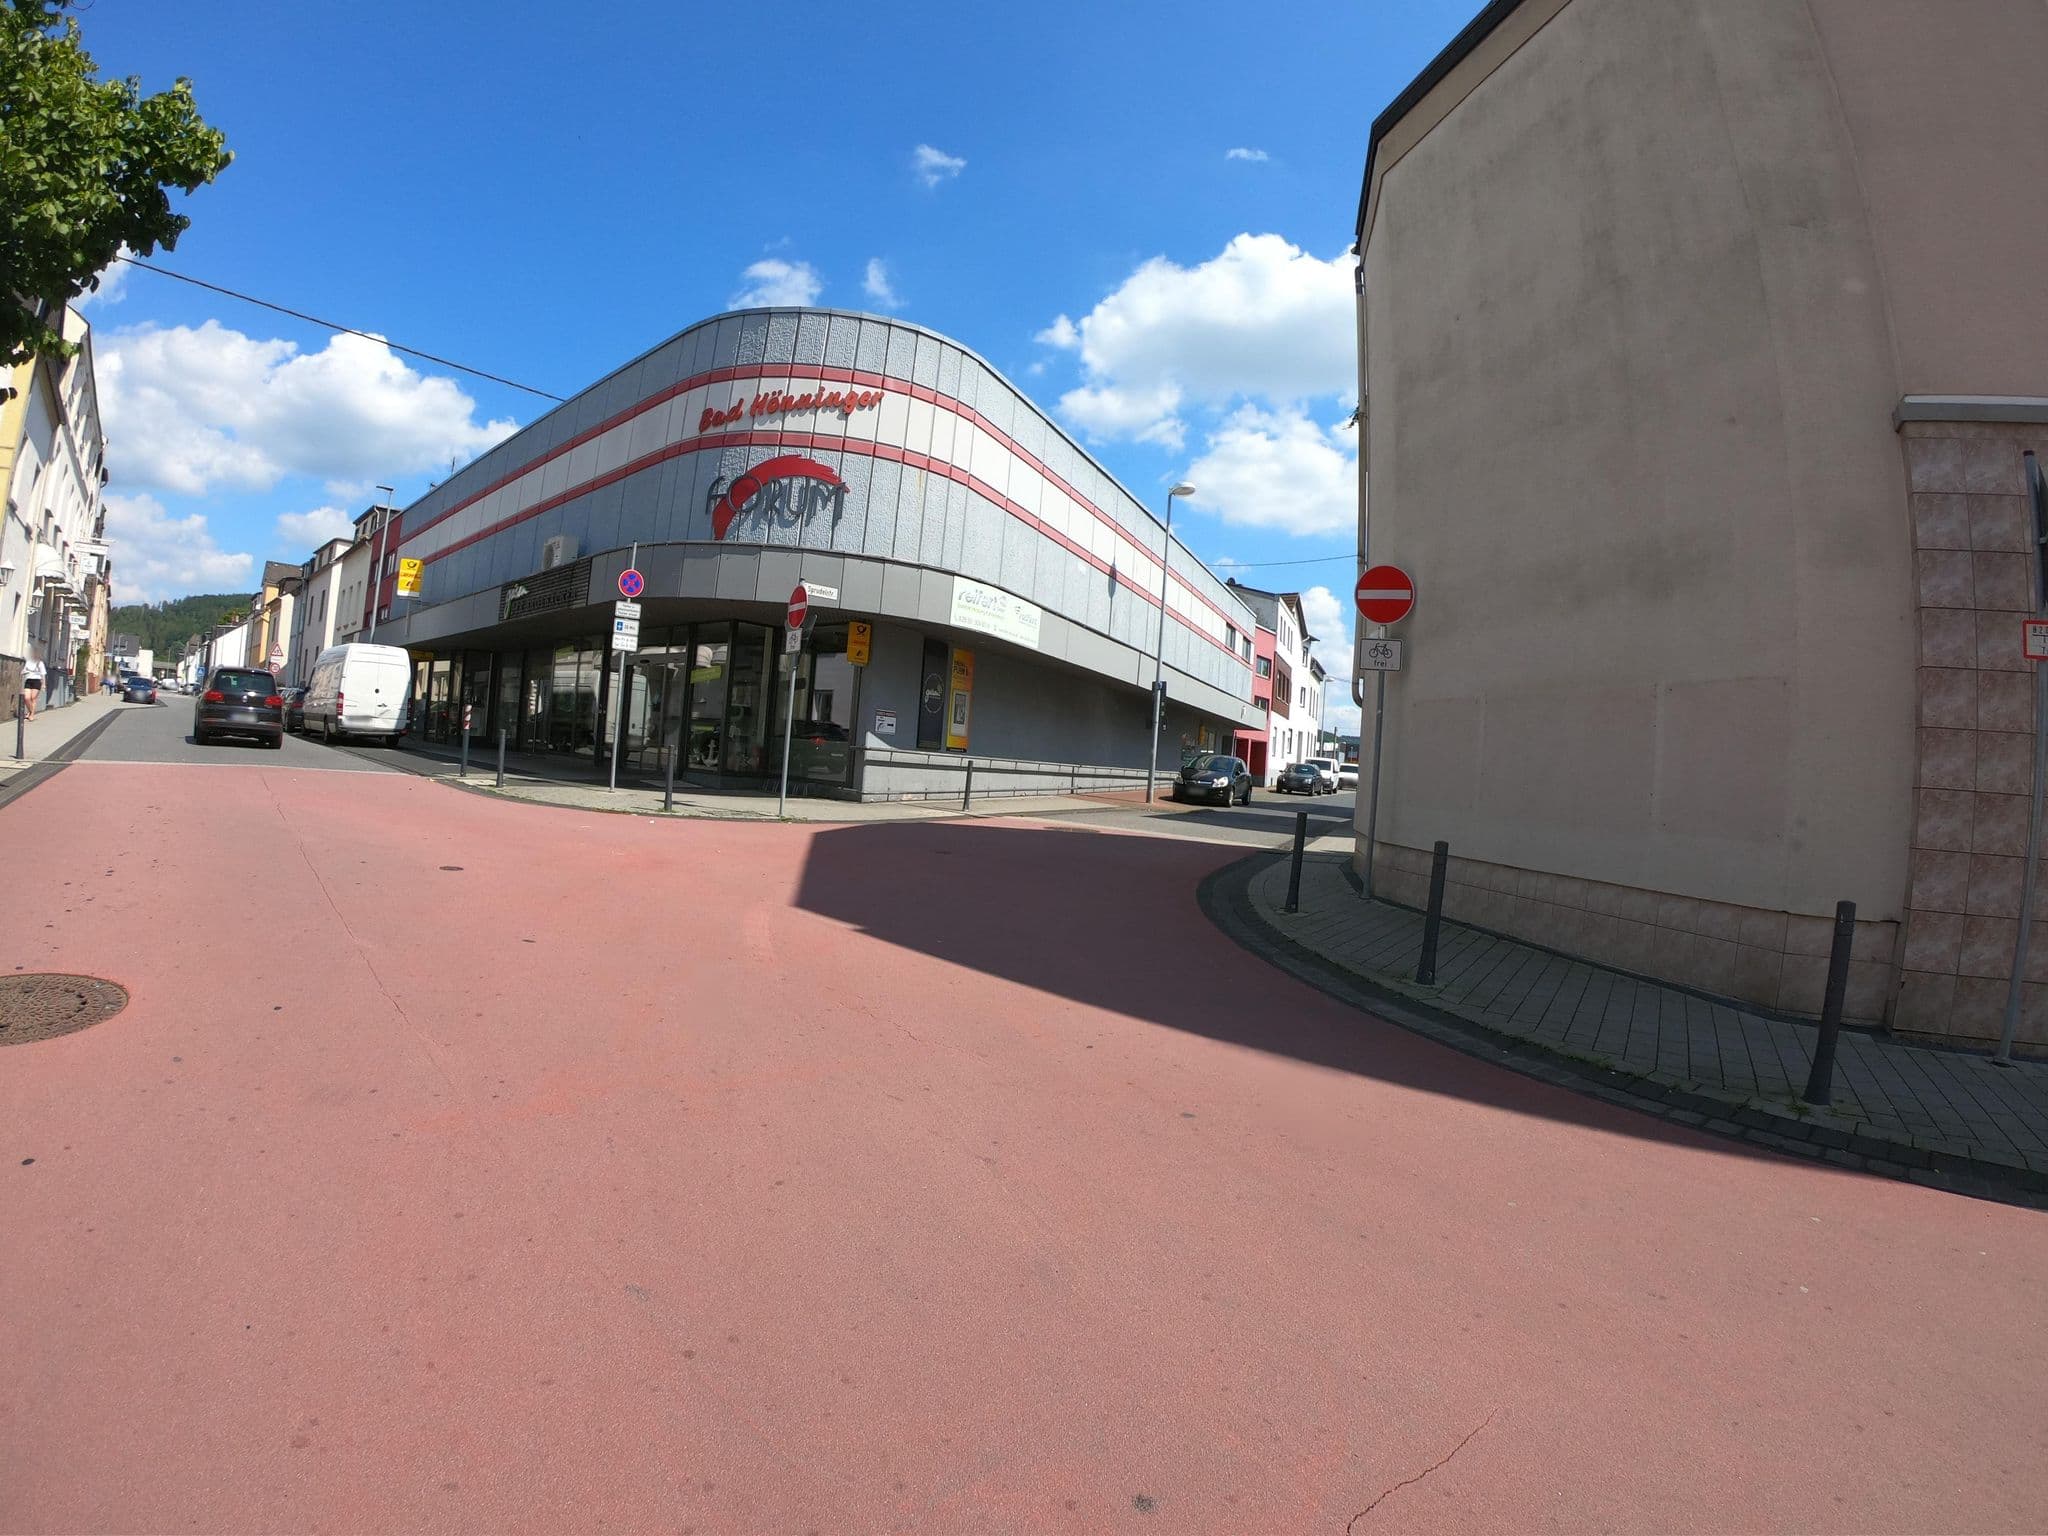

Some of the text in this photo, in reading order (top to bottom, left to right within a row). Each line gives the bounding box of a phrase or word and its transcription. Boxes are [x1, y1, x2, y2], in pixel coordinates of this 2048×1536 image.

[699, 386, 885, 432] Bad Hönninger
[705, 475, 846, 520] FORUM
[1374, 659, 1387, 667] frei
